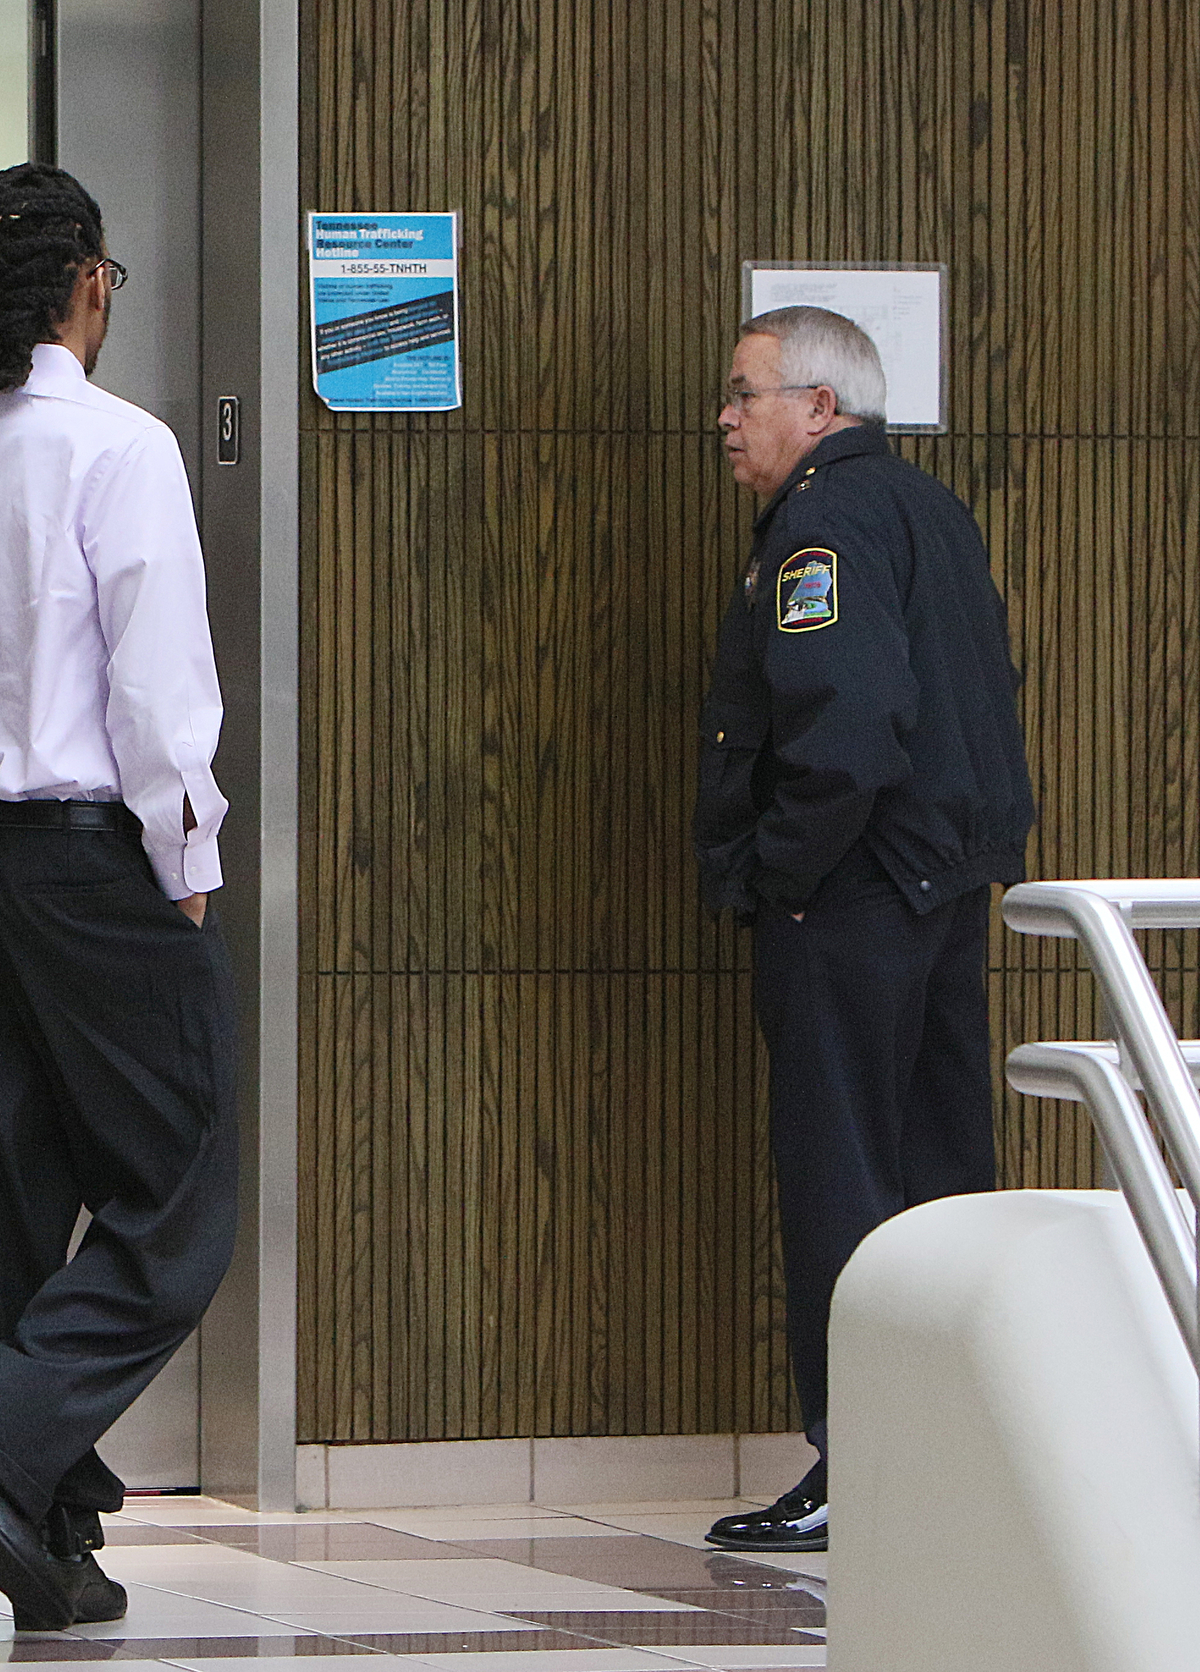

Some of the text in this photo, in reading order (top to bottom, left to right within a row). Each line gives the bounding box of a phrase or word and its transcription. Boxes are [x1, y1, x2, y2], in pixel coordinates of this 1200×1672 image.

[316, 221, 378, 230] Tennessee
[316, 229, 424, 240] Human Trafficking
[316, 239, 414, 249] Resource Center
[316, 248, 359, 258] Hotline
[341, 264, 427, 274] 1-855-55-TNHTH
[223, 402, 232, 441] 3
[781, 564, 832, 582] SHERIFF
